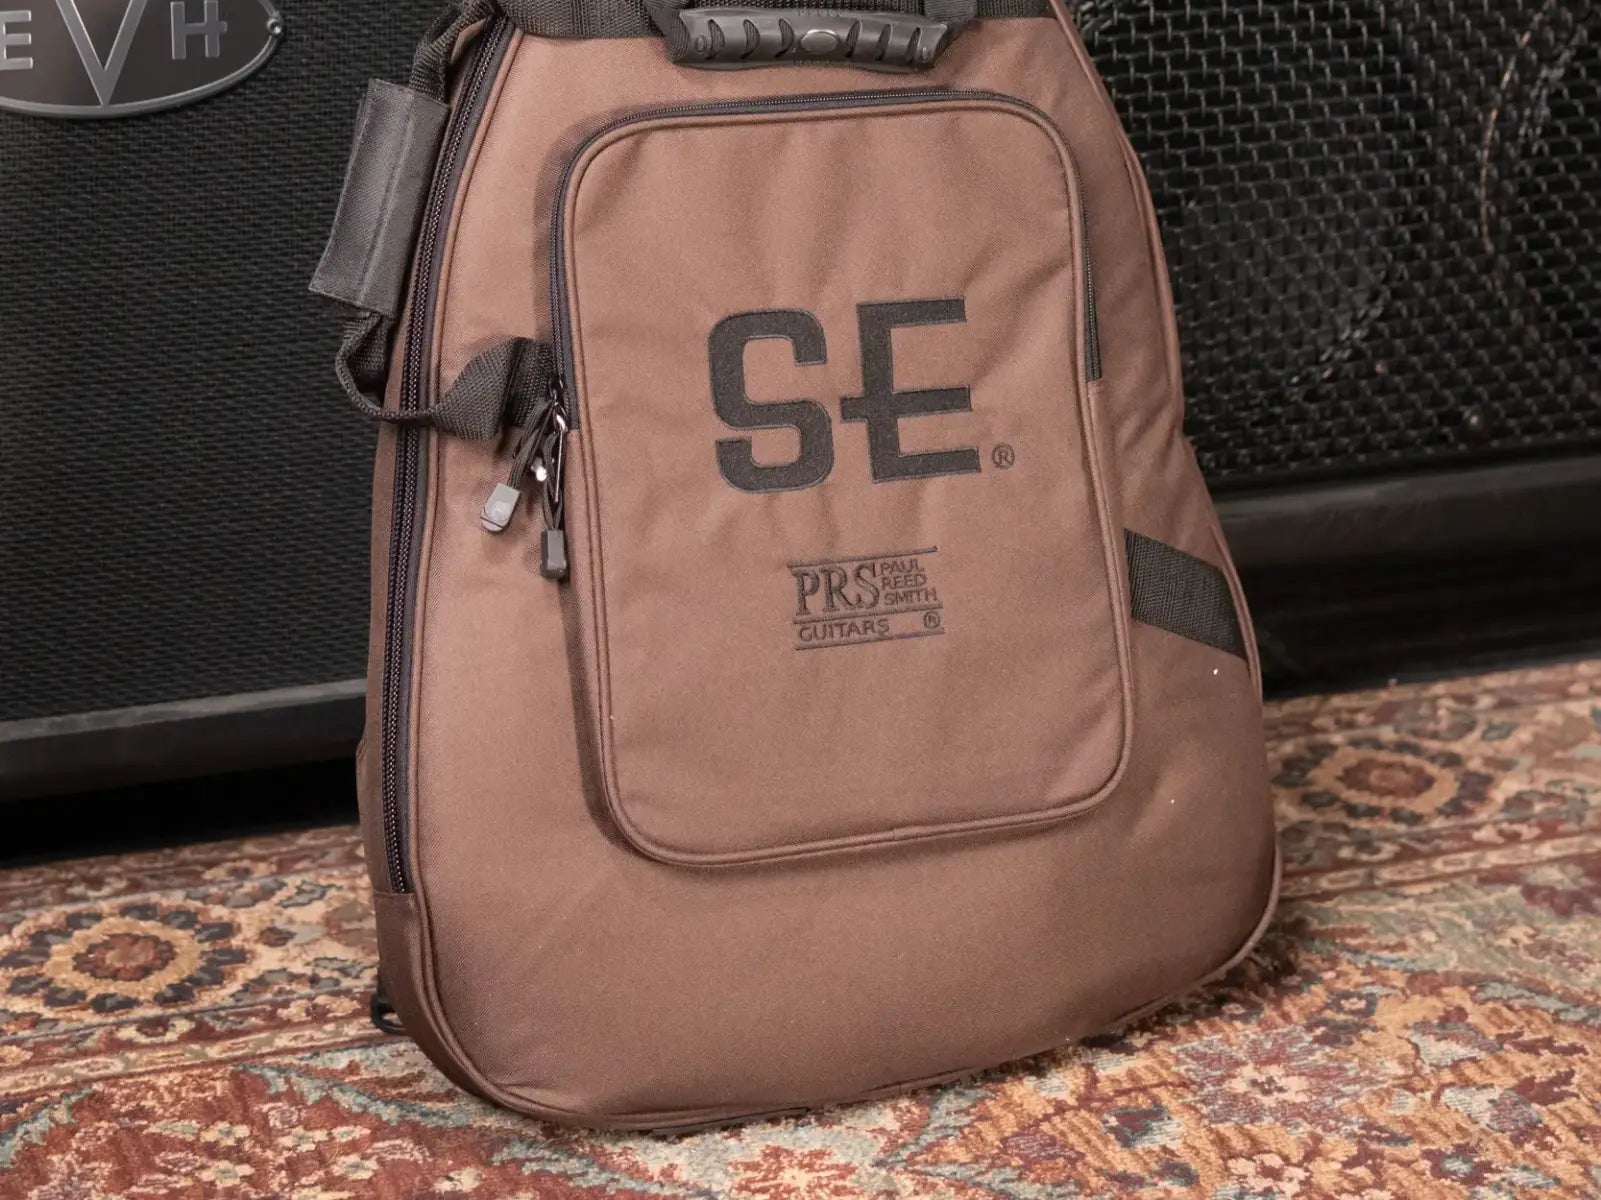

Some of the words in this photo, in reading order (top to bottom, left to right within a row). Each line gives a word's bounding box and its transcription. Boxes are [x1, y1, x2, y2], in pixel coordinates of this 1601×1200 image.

[707, 297, 982, 494] SE
[880, 558, 924, 575] PAUL
[792, 563, 880, 616] PRS
[882, 574, 927, 590] REED
[884, 587, 938, 606] SMITH
[799, 618, 890, 642] GUITARS
